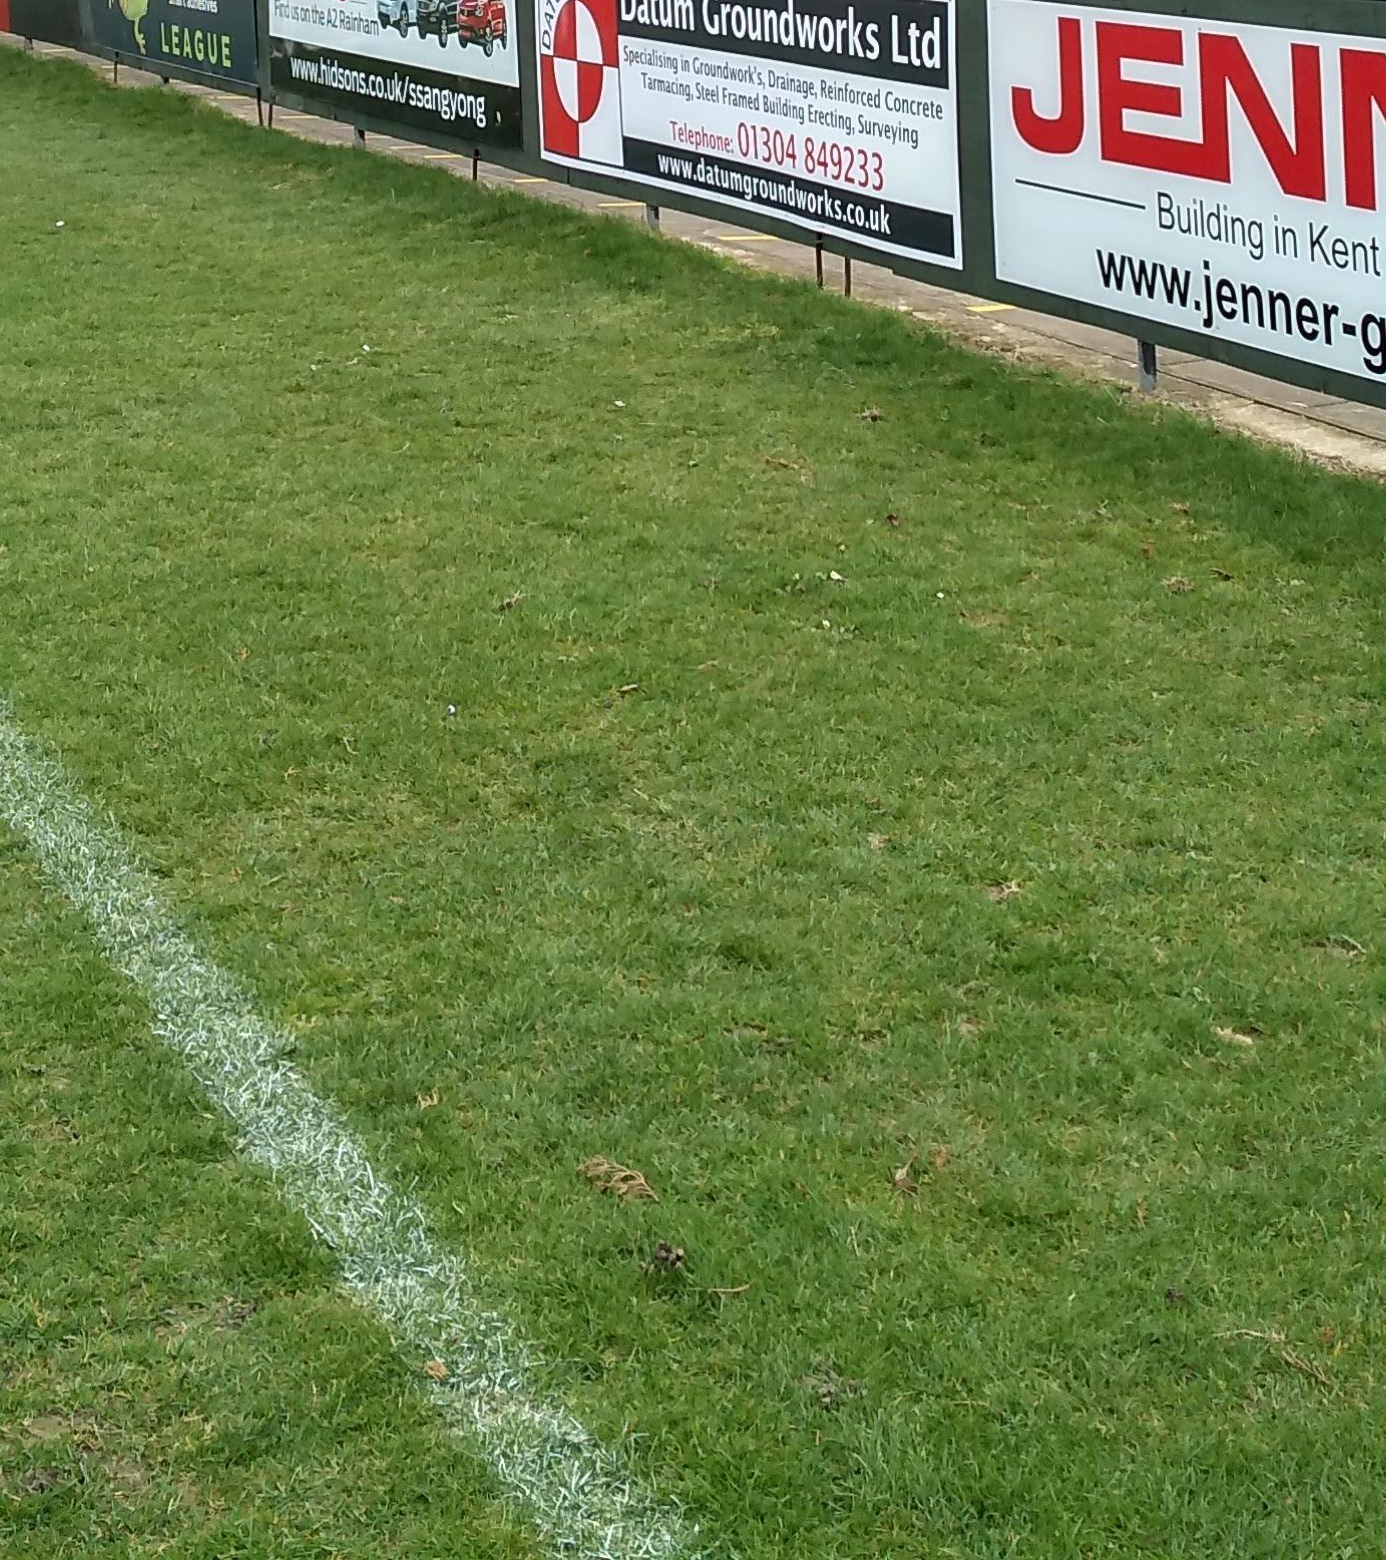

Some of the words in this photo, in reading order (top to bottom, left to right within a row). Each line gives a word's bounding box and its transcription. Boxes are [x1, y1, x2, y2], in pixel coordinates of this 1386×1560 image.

[160, 22, 232, 68] LEAGUE
[291, 6, 300, 22] us
[300, 6, 311, 23] on
[311, 4, 325, 26] the
[326, 7, 339, 29] A2
[339, 10, 380, 36] Rainham
[891, 14, 942, 69] Ltd
[290, 56, 487, 128] www.hidsons.co.uk/ssangyong
[623, 44, 679, 75] Specialising
[681, 59, 690, 74] in
[692, 56, 765, 85] Groundwork's,
[768, 69, 817, 100] Drainage,
[820, 79, 881, 109] Reinforced
[884, 90, 943, 120] Concrete
[640, 72, 694, 102] Tarmacing,
[695, 82, 720, 104] Steel
[722, 86, 760, 112] Framed
[763, 94, 805, 125] Building
[807, 104, 855, 136] Erecting,
[857, 114, 919, 149] Surveying
[669, 120, 734, 154] Telephone:
[737, 122, 797, 169] 01304
[804, 137, 884, 191] 849233
[657, 153, 891, 235] www.datumgroundworks.co.uk
[1156, 191, 1265, 260] Building
[1273, 213, 1299, 259] in
[1309, 220, 1381, 278] Kent
